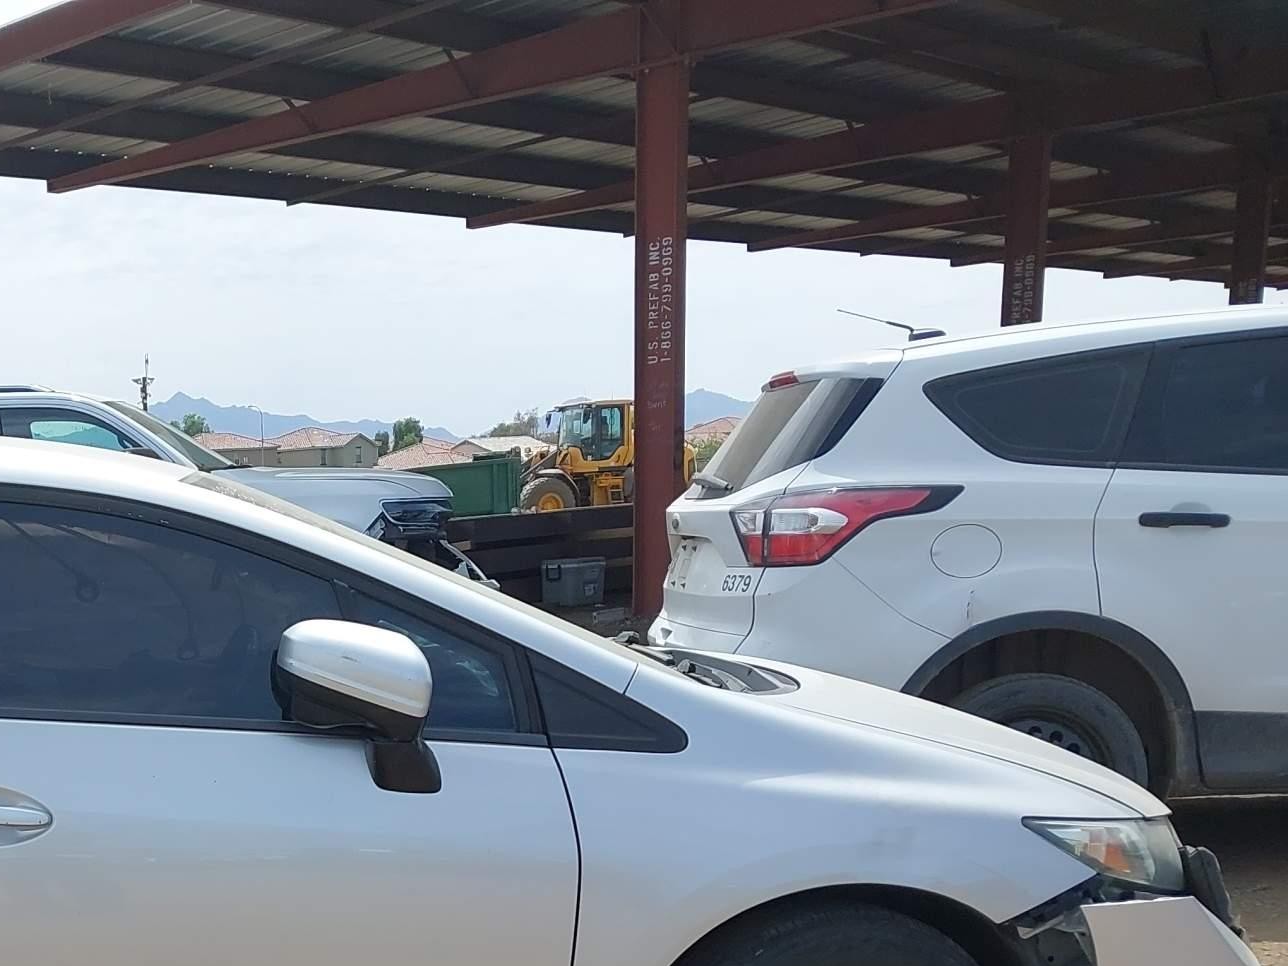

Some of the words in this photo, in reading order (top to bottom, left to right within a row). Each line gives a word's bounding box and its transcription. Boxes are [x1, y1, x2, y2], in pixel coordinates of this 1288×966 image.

[649, 236, 660, 265] INC.
[648, 272, 659, 328] PREFAB
[647, 337, 659, 364] U.S.
[722, 574, 752, 592] 6379
